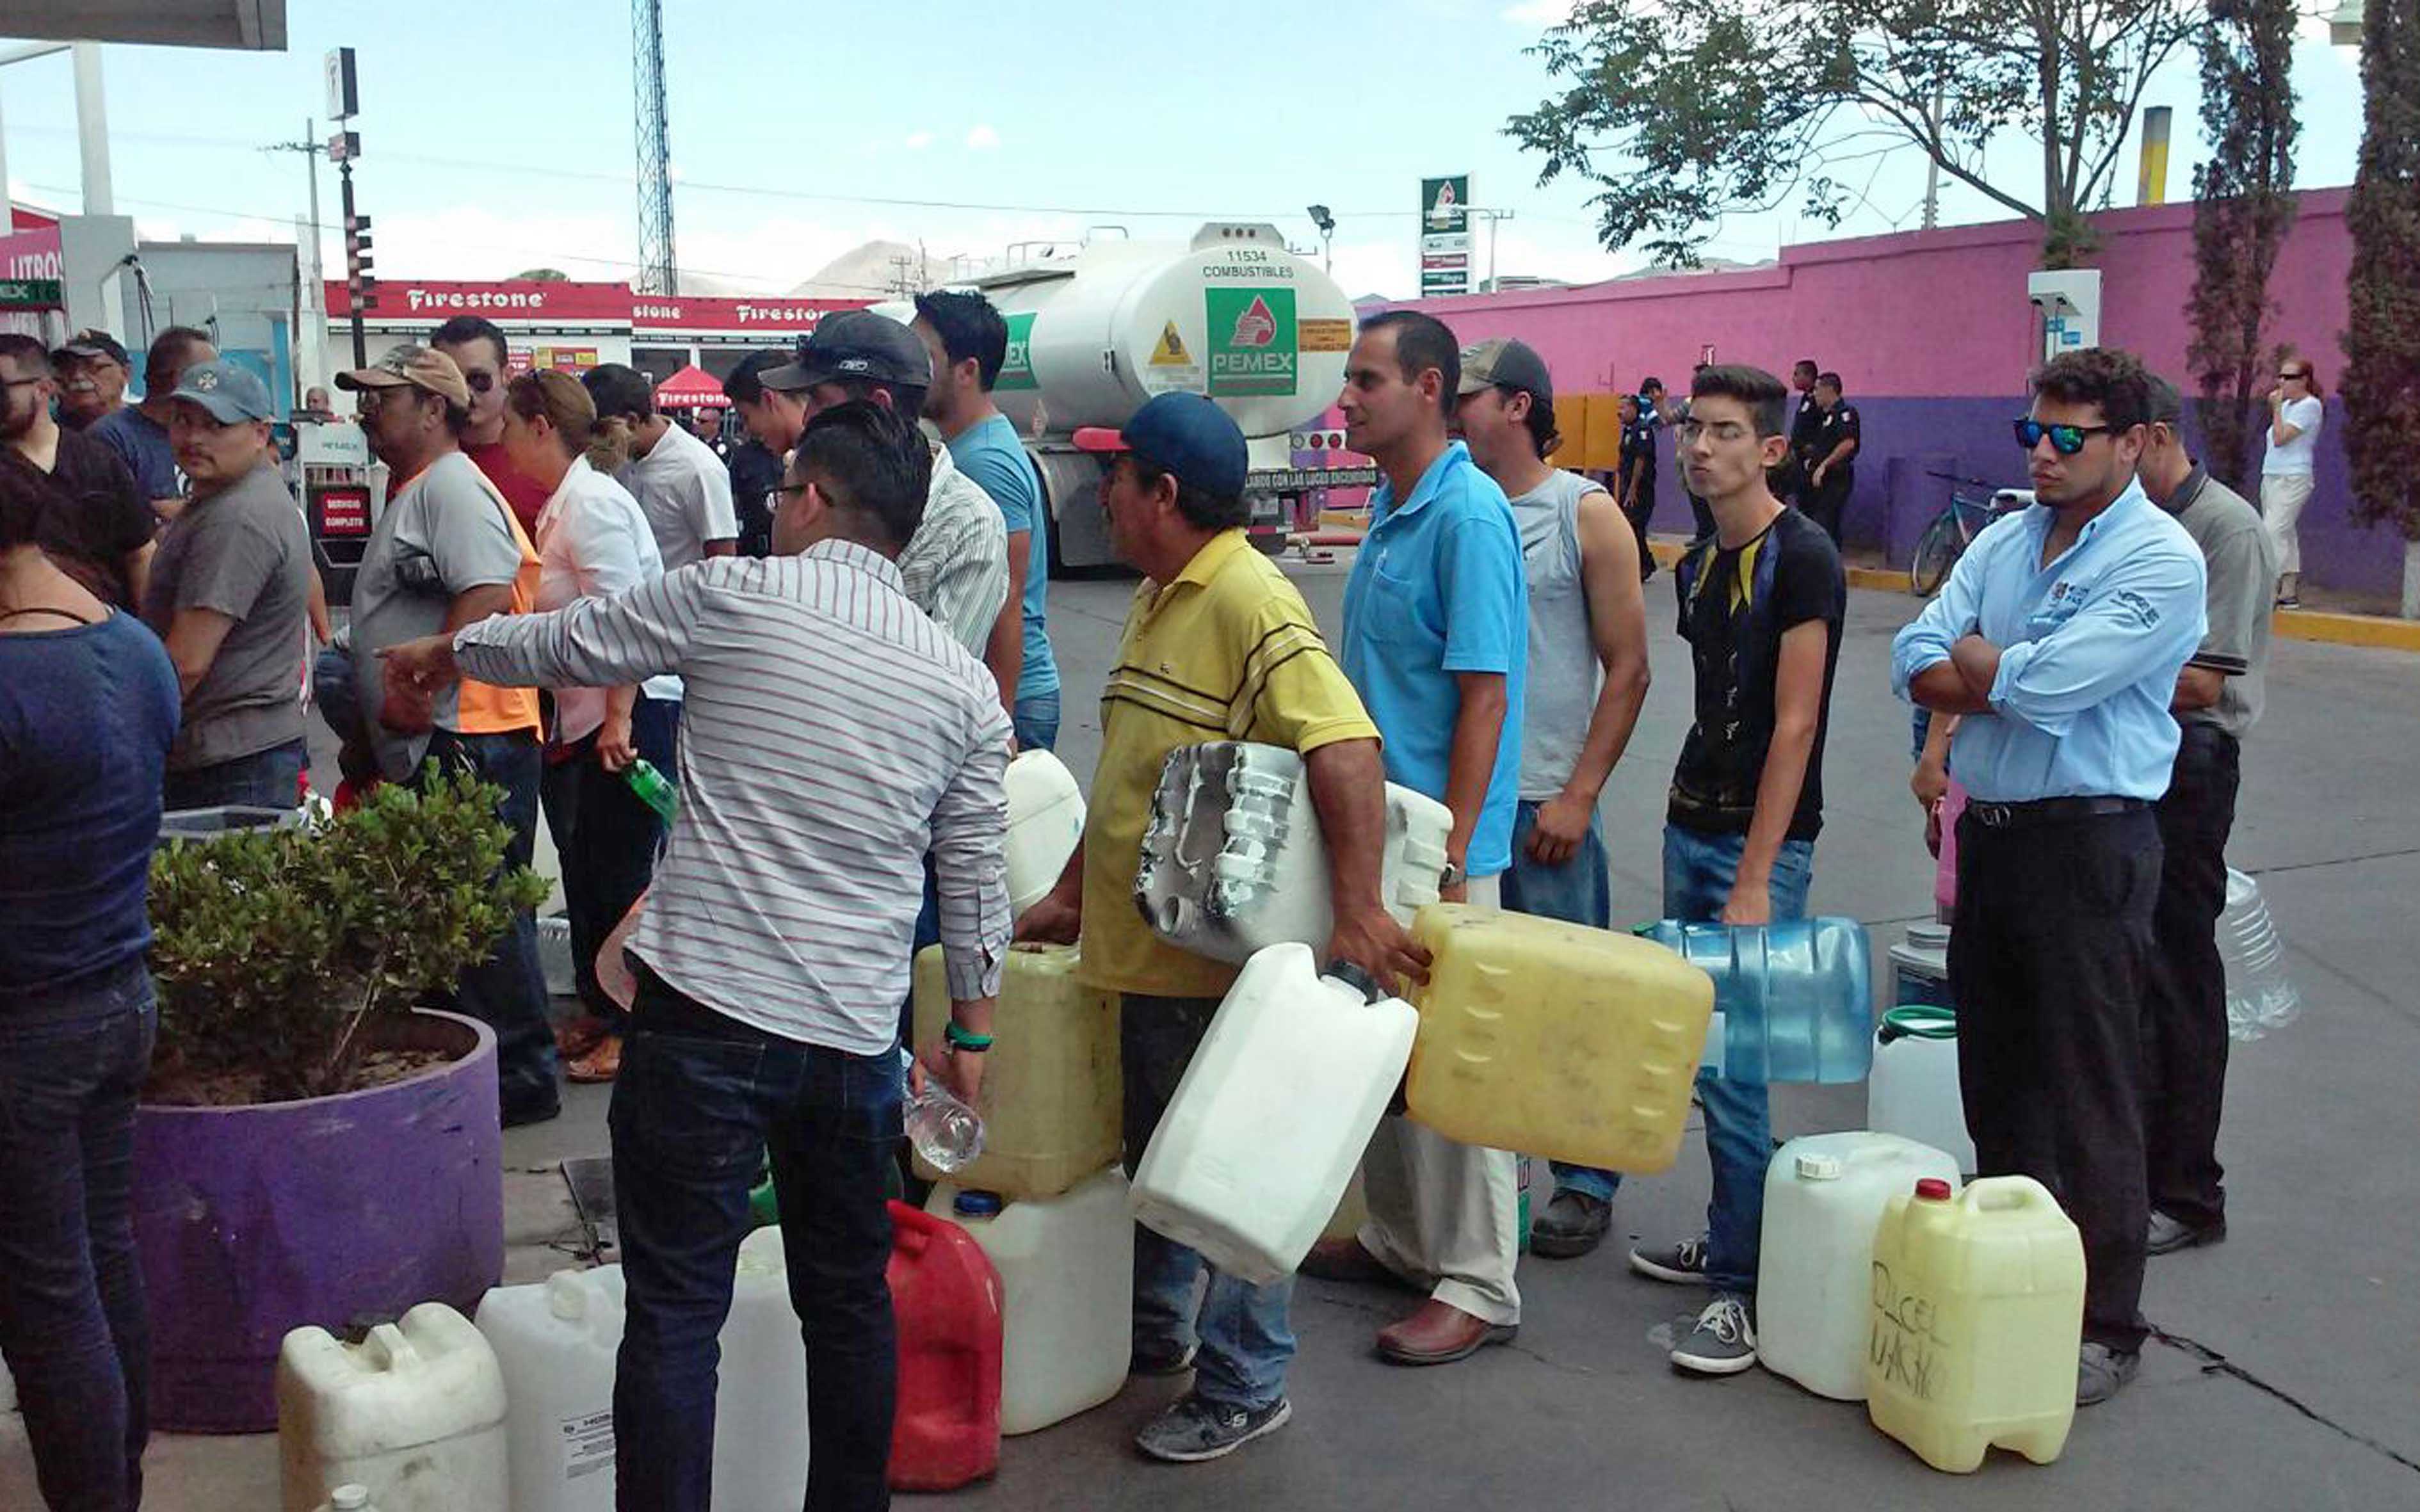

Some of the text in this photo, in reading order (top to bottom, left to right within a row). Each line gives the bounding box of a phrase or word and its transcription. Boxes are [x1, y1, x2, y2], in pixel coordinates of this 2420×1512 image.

[1227, 250, 1268, 262] 11534
[1202, 266, 1295, 278] COMBUSTIBLES
[407, 289, 546, 310] Firestone
[633, 305, 681, 318] stone
[1213, 352, 1293, 371] PEMEX
